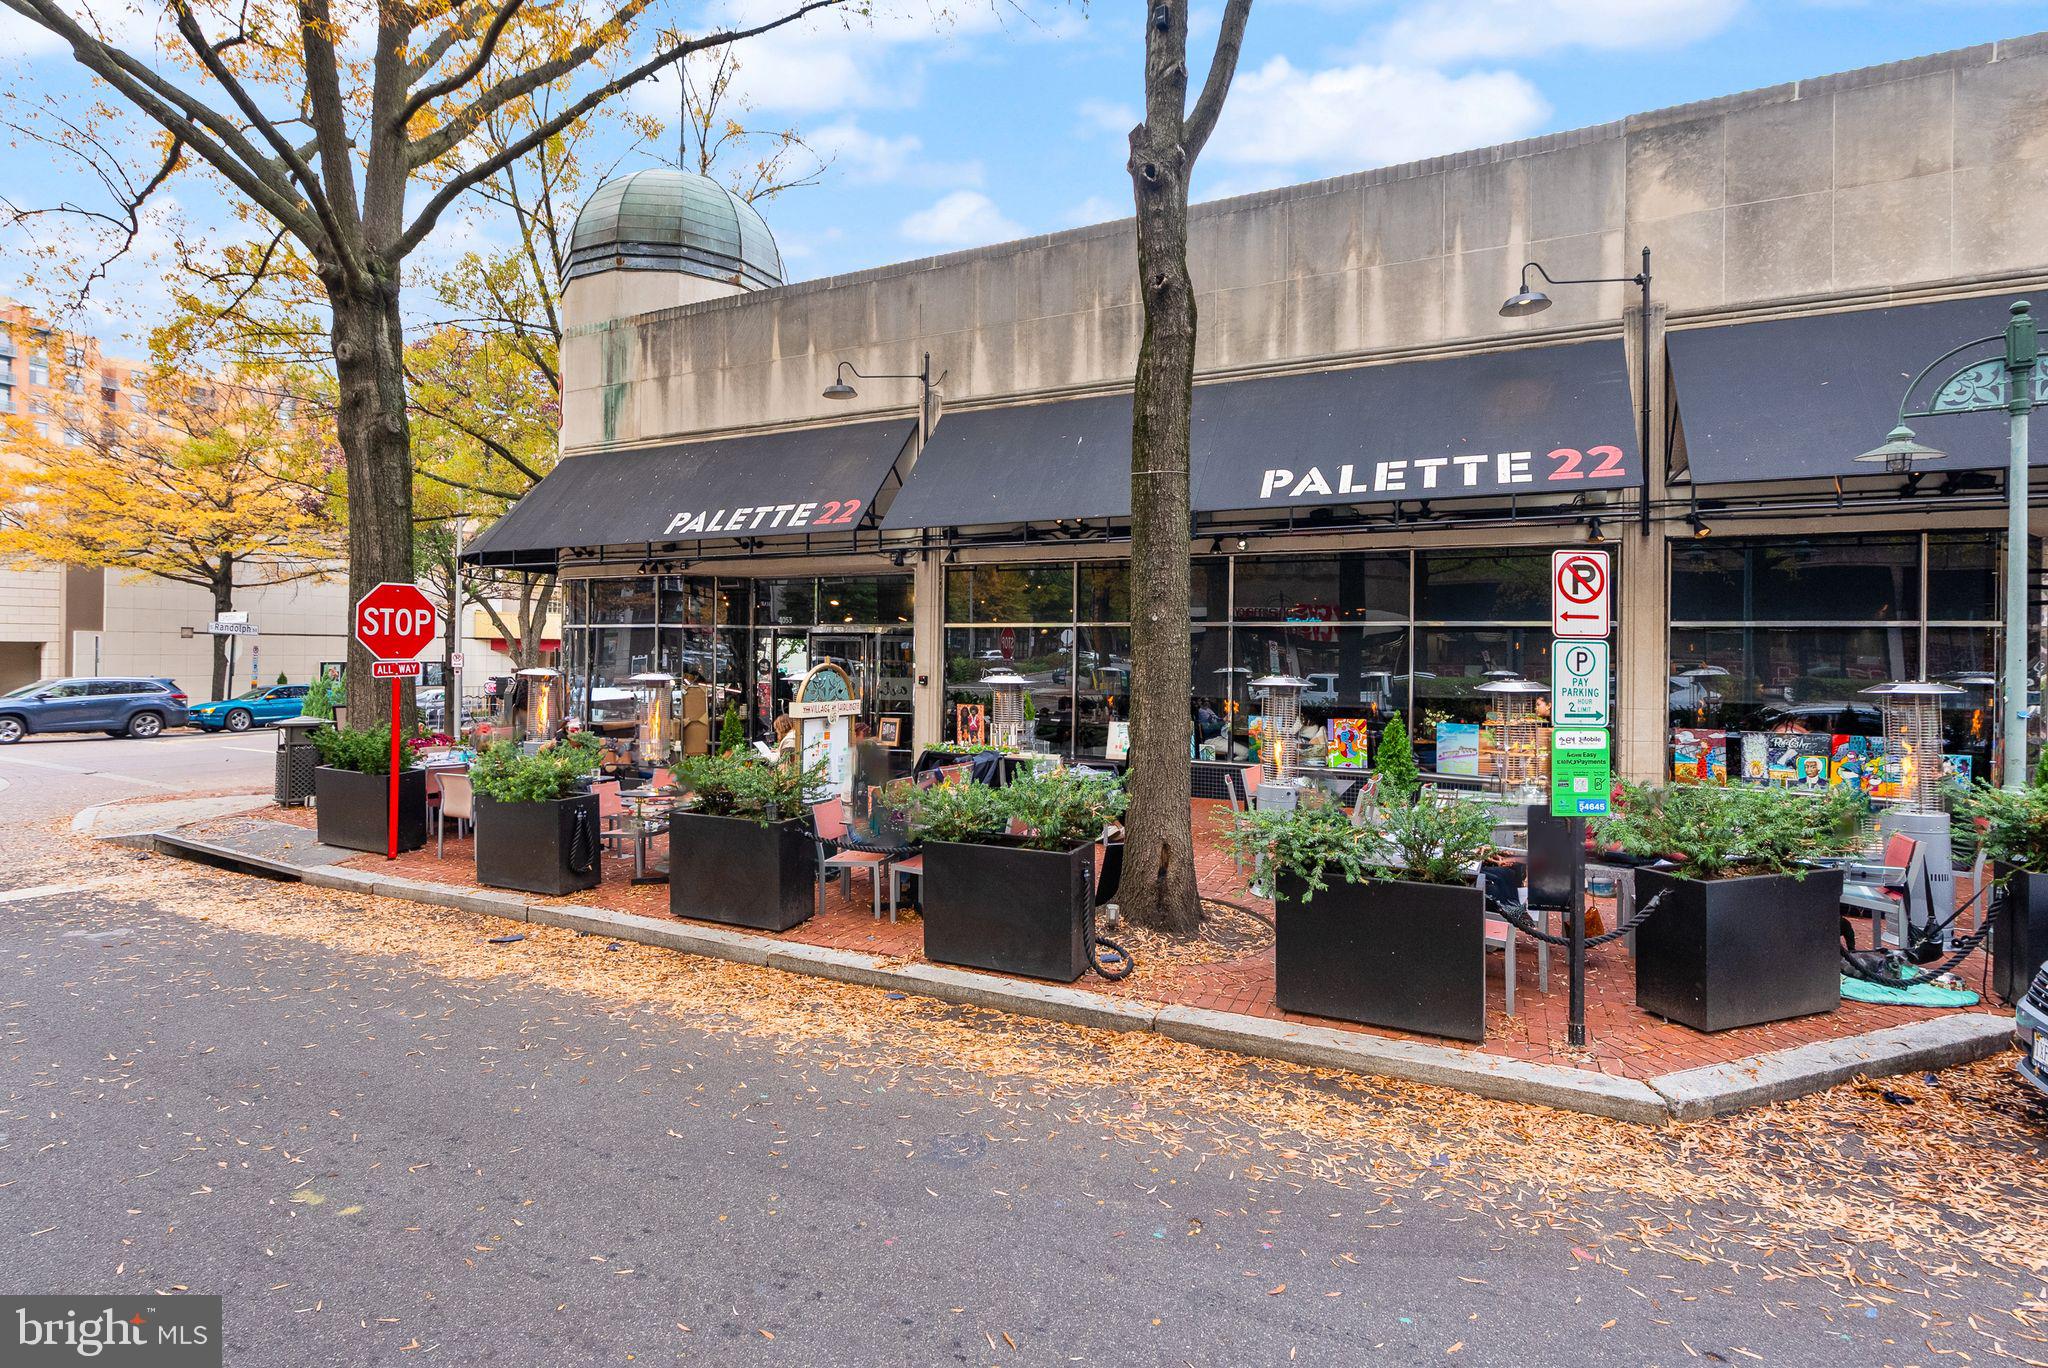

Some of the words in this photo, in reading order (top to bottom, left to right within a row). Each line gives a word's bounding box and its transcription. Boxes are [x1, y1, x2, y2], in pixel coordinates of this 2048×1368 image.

[1259, 452, 1533, 498] PALETTE
[1547, 445, 1625, 480] 22
[664, 502, 817, 535] PALETTE
[812, 498, 862, 525] 22
[362, 607, 431, 636] STOP
[214, 623, 252, 634] Randolph
[377, 665, 393, 674] ALL
[398, 664, 417, 673] WAY
[1572, 678, 1589, 686] PAY
[1562, 687, 1599, 697] PARKING
[1568, 702, 1576, 712] 2
